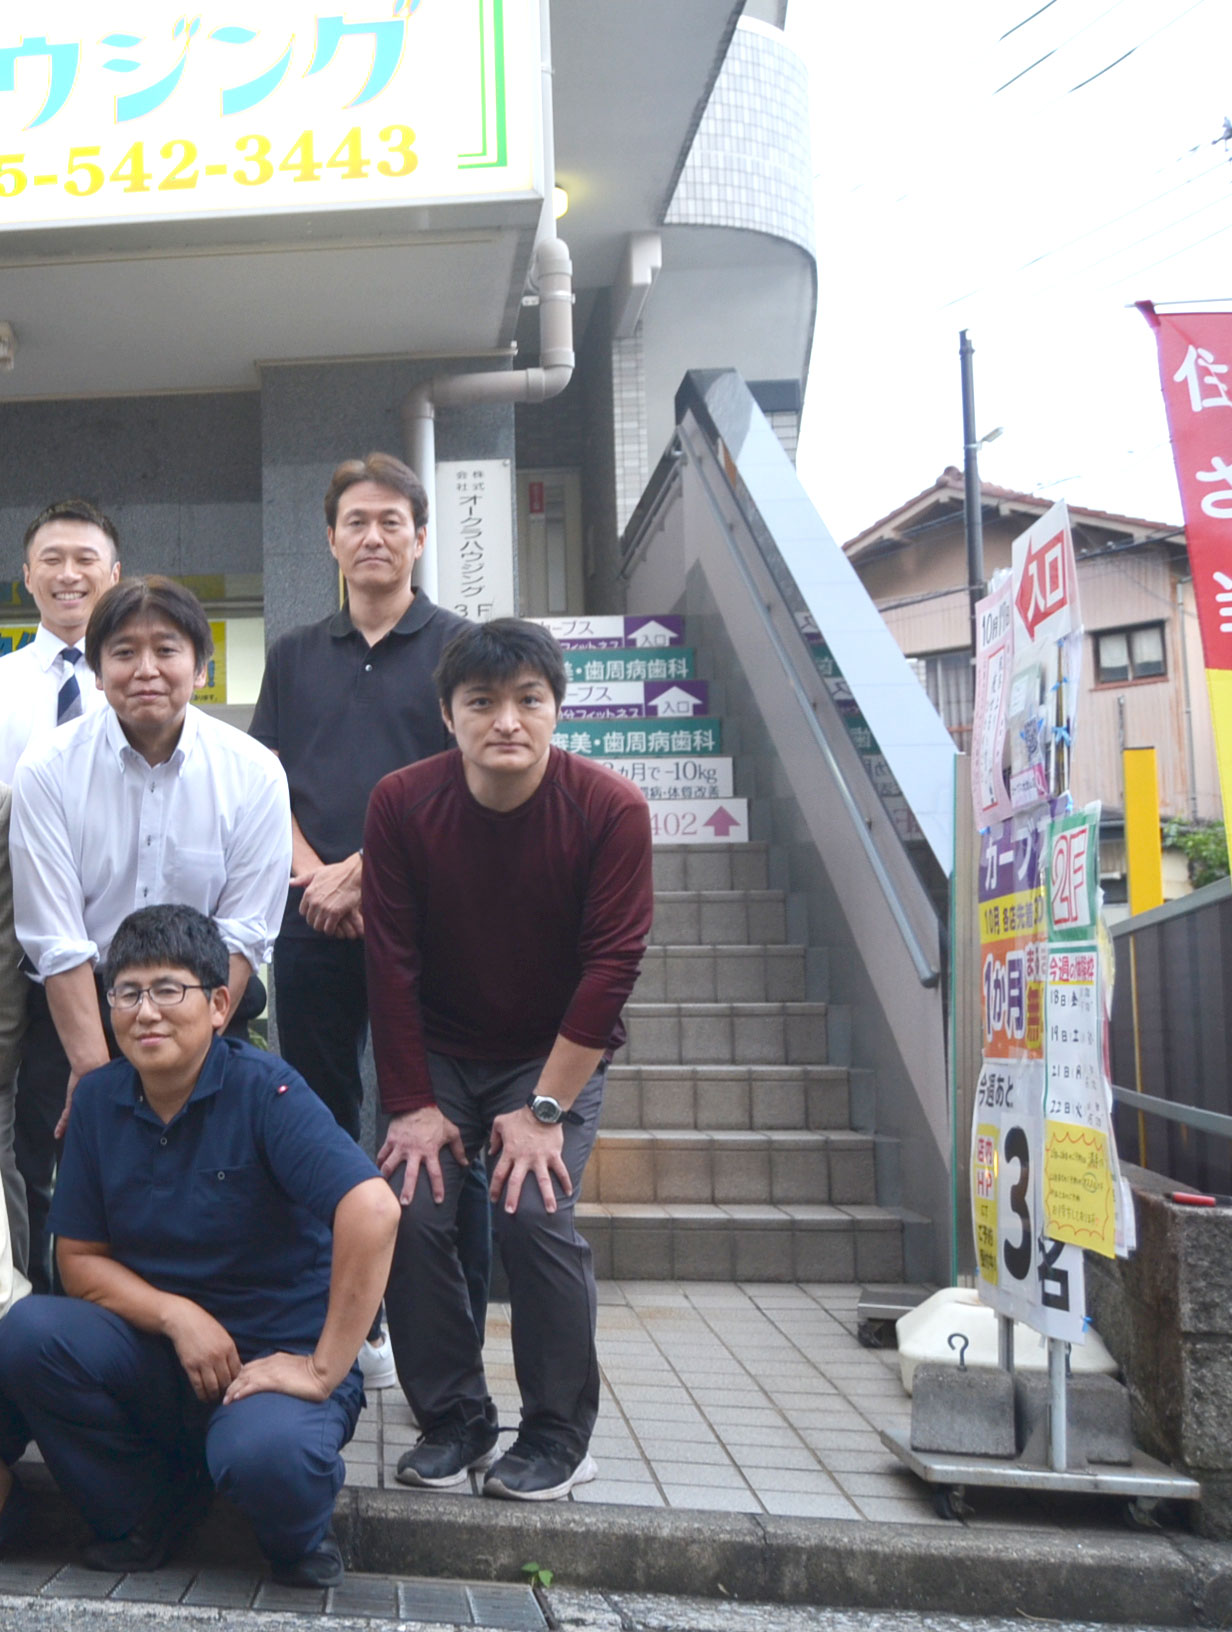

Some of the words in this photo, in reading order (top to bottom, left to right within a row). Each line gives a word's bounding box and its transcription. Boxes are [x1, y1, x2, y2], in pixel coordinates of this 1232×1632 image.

[459, 494, 485, 598] オークラハウジング
[641, 634, 667, 648] 入口
[662, 701, 690, 715] 入口
[1051, 829, 1088, 926] 2F
